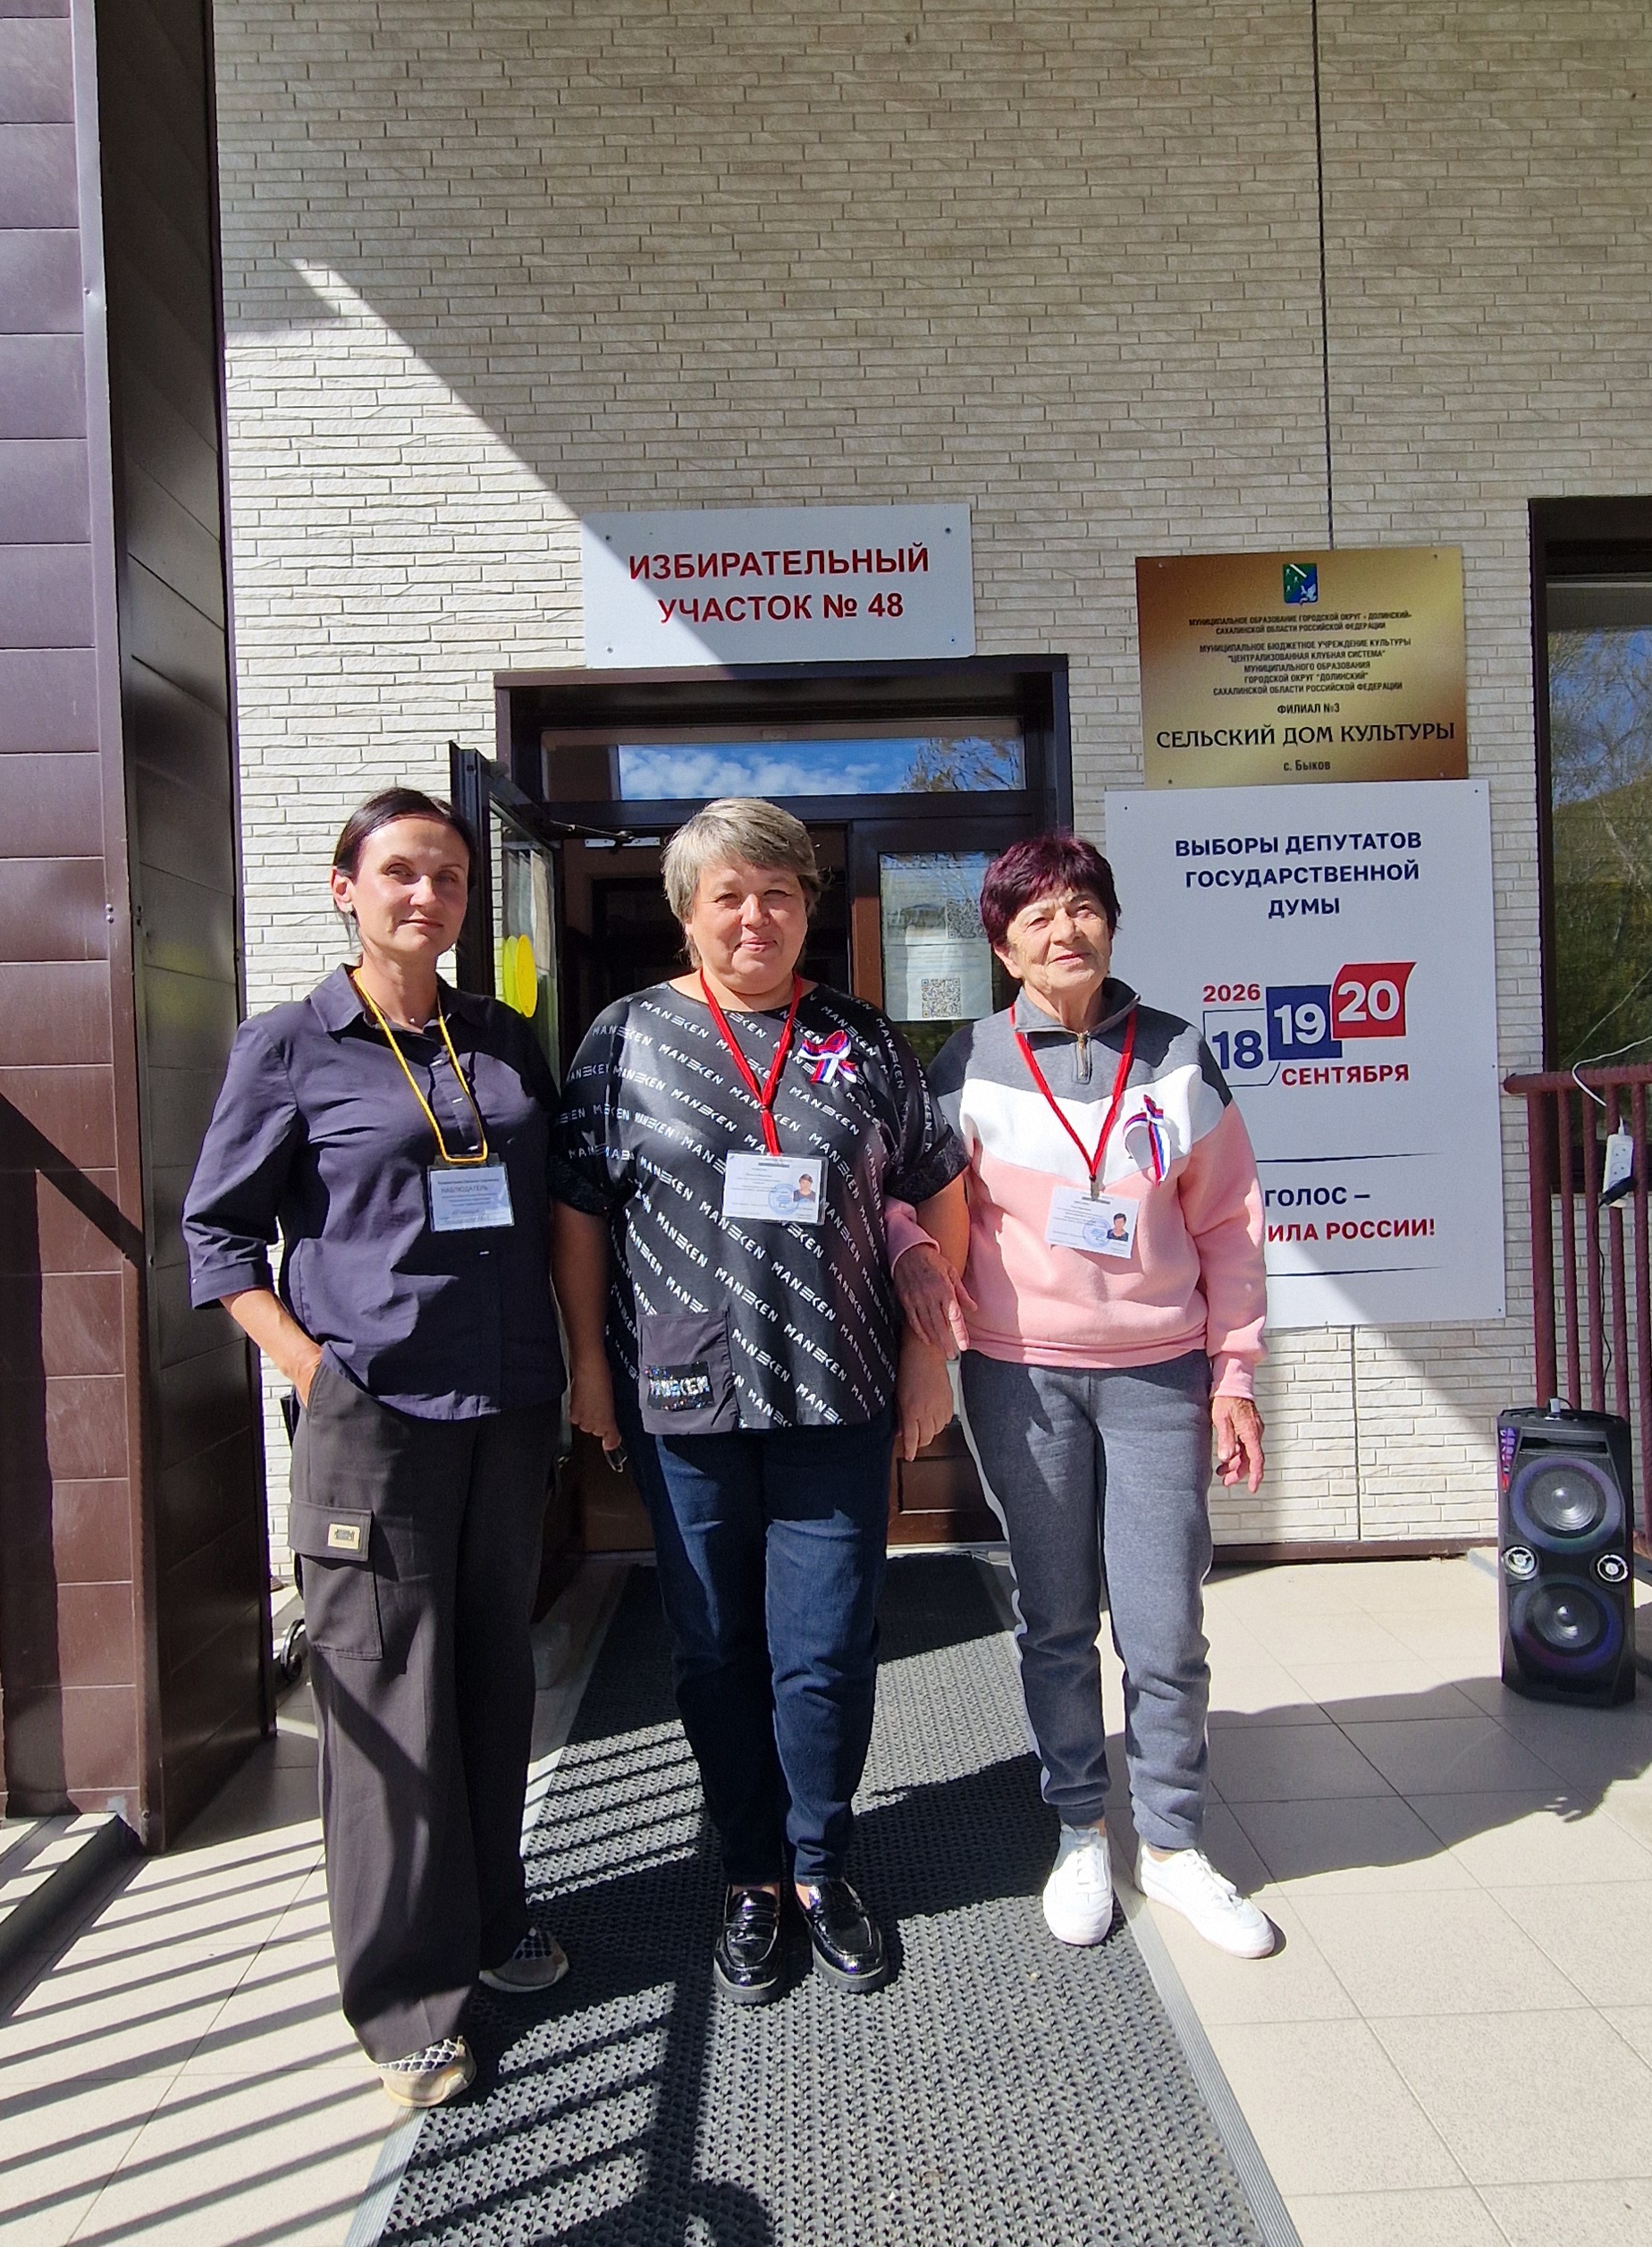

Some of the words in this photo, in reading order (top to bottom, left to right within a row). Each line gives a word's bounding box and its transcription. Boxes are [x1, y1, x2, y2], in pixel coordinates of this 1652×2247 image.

[629, 541, 929, 580] ИЗБИРАТЕЛЬНЫЙ
[657, 595, 812, 624] УЧАСТОК
[823, 594, 858, 619] №
[867, 593, 904, 618] 48
[1189, 617, 1248, 626] МУНИЦИПАЛЬНОЕ
[1250, 615, 1297, 624] ОБРАЗОВАНИЕ
[1299, 612, 1339, 621] ГОРОДСКОЙ
[1341, 612, 1362, 621] ОКРУГ
[1216, 625, 1265, 635] САХАЛИНСКОЙ
[1267, 625, 1297, 633] ОБЛАСТИ
[1299, 622, 1343, 631] РОССИЙСКОЙ
[1344, 621, 1386, 630] ФЕДЕРАЦИИ
[1200, 643, 1265, 653] МУНИЦИПАЛЬНОЕ
[1267, 641, 1316, 651] БЮДЖЕТНОЕ
[1318, 639, 1369, 649] УЧРЕЖДЕНИЕ
[1370, 638, 1412, 646] КУЛЬТУРЫ
[1311, 651, 1346, 660] КЛУБНАЯ
[1243, 663, 1315, 672] МУНИЦИПАЛЬНОГО
[1317, 661, 1370, 670] ОБРАЗОВАНИЯ
[1213, 684, 1268, 696] САХАЛИНСКОЙ
[1269, 685, 1304, 694] ОБЛАСТИ
[1306, 682, 1355, 692] РОССИЙСКОЙ
[1356, 681, 1403, 691] ФЕДЕРАЦИИ
[1244, 673, 1289, 684] ГОРОДСКОЙ
[1290, 674, 1314, 682] ОКРУГ
[1277, 703, 1321, 714] ФИЛИАЛ
[1156, 723, 1276, 748] СЕЛЬСКИЙ
[1283, 725, 1334, 748] ДОМ
[1341, 722, 1454, 743] КУЛЬТУРЫ
[1283, 762, 1293, 772] с.
[1295, 760, 1331, 772] Быков
[1175, 837, 1279, 857] ВЫБОРЫ
[1285, 832, 1422, 856] ДЕПУТАТОВ
[1185, 858, 1420, 888] ГОСУДАРСТВЕННОЙ
[1268, 897, 1341, 919] ДУМЫ
[1202, 983, 1261, 1003] 2026
[1211, 1029, 1264, 1070] 18
[1273, 1002, 1327, 1046] 19
[1337, 980, 1401, 1023] 20
[1281, 1063, 1410, 1086] СЕНТЯБРЯ
[1264, 1187, 1348, 1207] ГОЛОС
[1267, 1222, 1319, 1243] ИЛА
[1326, 1218, 1436, 1241] РОССИИ!
